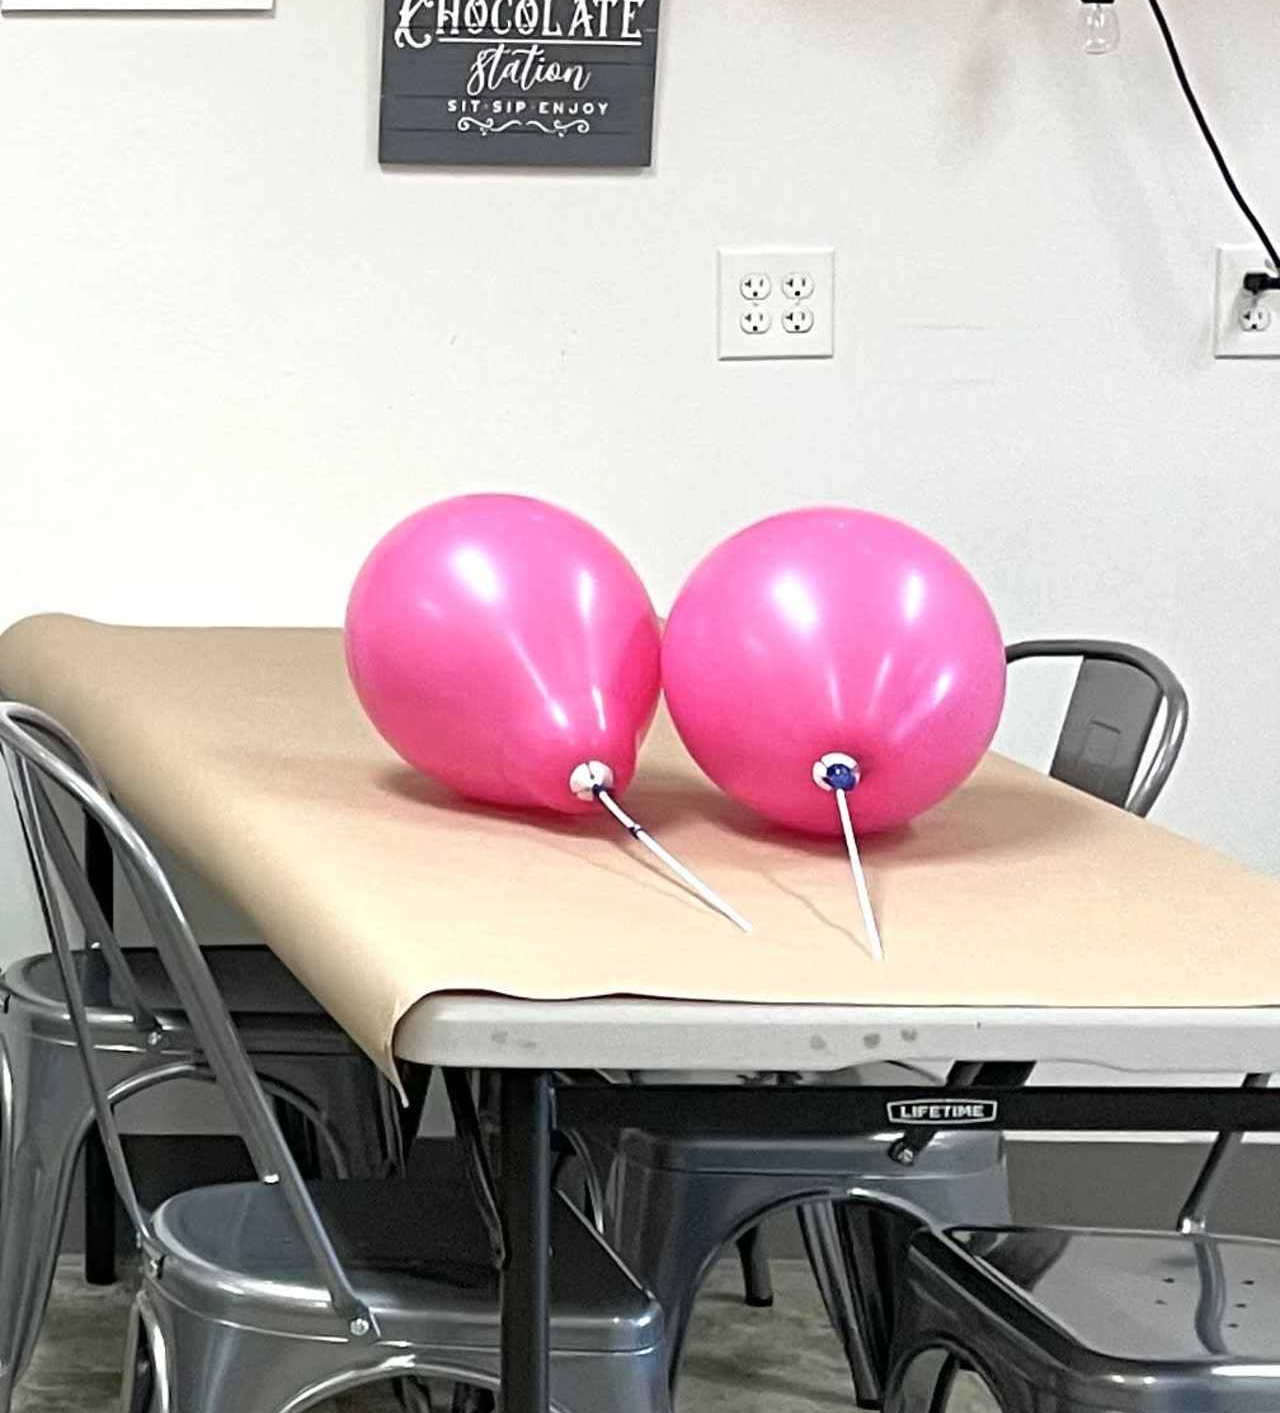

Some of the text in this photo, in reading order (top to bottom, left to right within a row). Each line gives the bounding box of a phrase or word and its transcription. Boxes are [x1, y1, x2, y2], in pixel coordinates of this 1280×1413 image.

[447, 99, 610, 116] SIT SIP ENJOY
[899, 1104, 985, 1120] LIFETIME
